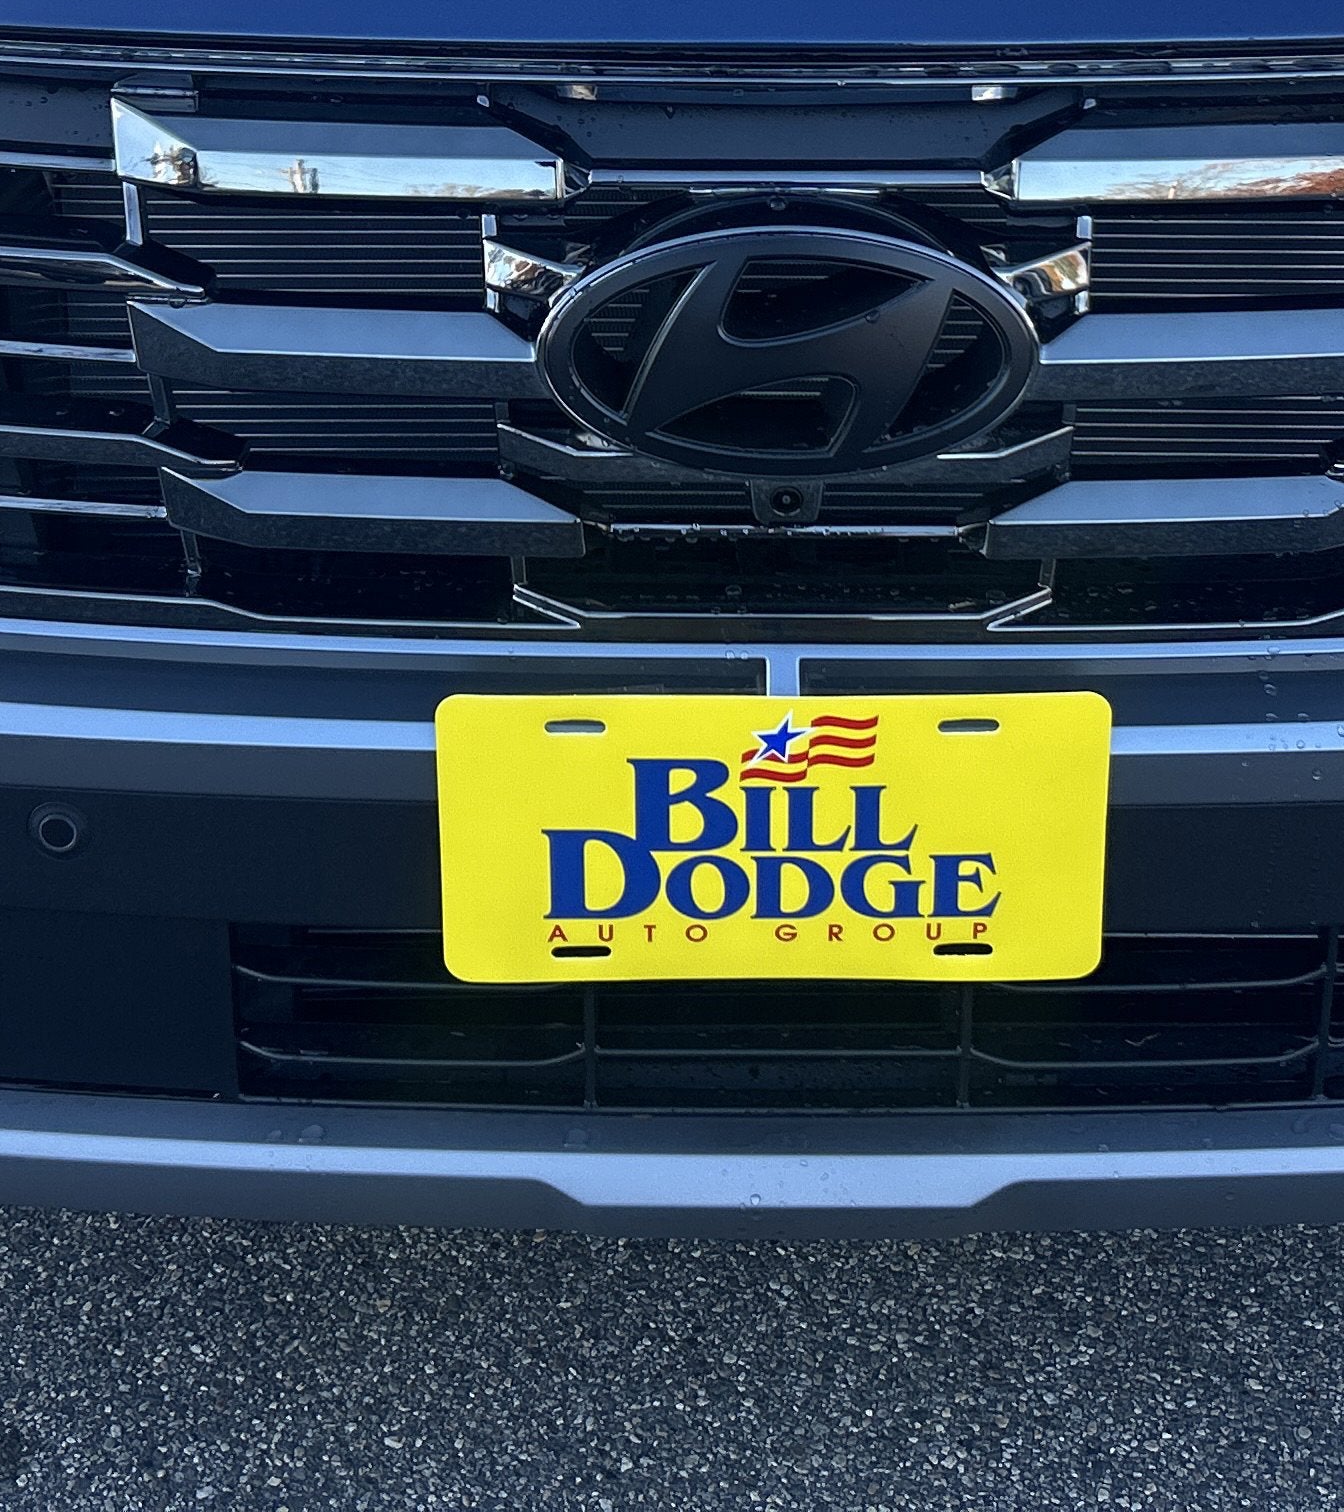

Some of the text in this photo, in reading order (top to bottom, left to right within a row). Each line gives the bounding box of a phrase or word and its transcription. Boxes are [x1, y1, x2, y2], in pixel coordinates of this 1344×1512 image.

[626, 757, 919, 853] BILL
[540, 828, 1003, 920] DODGE
[547, 922, 989, 943] AUTO GROUP
